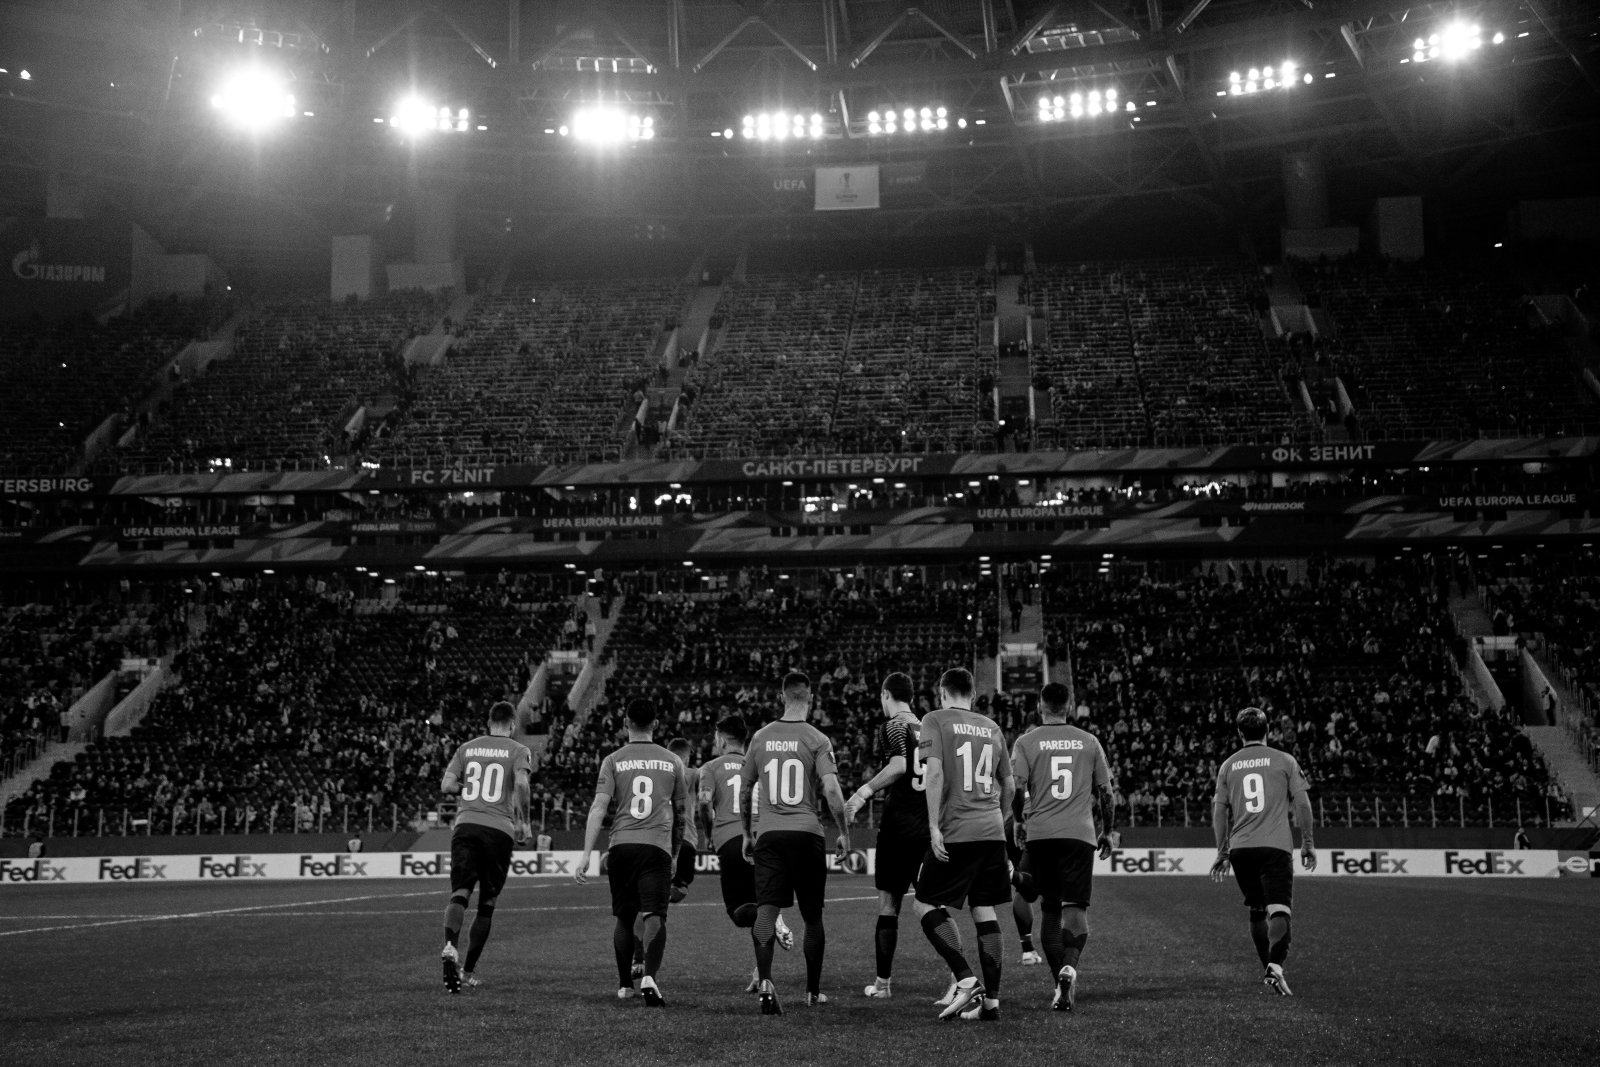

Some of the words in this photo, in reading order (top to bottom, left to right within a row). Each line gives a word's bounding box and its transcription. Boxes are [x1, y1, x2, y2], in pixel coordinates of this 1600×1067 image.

[773, 179, 806, 191] UEFA
[1271, 447, 1303, 462] ФК
[1309, 445, 1375, 461] ЗЕНИТ
[742, 457, 923, 476] САНКТ-ПЕТЕРБУРГ
[411, 470, 435, 484] FC
[1439, 497, 1472, 507] UEFA
[1475, 495, 1524, 506] EUROPA
[1527, 494, 1577, 504] LEAGUE
[977, 509, 1008, 518] UEFA
[1011, 507, 1056, 517] EUROPA
[1058, 505, 1103, 516] LEAGUE
[122, 527, 150, 537] UEFA
[153, 526, 196, 536] EUROPA
[198, 525, 240, 535] LEAGUE
[543, 518, 572, 528] UEFA
[574, 517, 617, 527] EUROPA
[619, 516, 662, 526] LEAGUE
[952, 723, 992, 739] KUZYAEV
[465, 747, 509, 758] MAMMANA
[765, 740, 798, 752] RIGONI
[1040, 740, 1083, 750] PAREDES
[615, 759, 674, 772] KRANEVITTER
[956, 741, 993, 794] 14
[1231, 757, 1271, 771] KOKORIN
[461, 761, 505, 803] 30
[764, 758, 804, 806] 10
[1050, 755, 1073, 800] 5
[630, 775, 653, 820] 8
[1242, 772, 1265, 814] 9
[0, 860, 67, 881] FedEx
[100, 858, 167, 880] FedEx
[200, 856, 267, 877] FedEx
[300, 855, 368, 876] FedEx
[400, 854, 452, 876] FedE
[1111, 850, 1184, 873] FedEx
[1331, 850, 1409, 874] FedEx
[1445, 851, 1526, 875] FedEx
